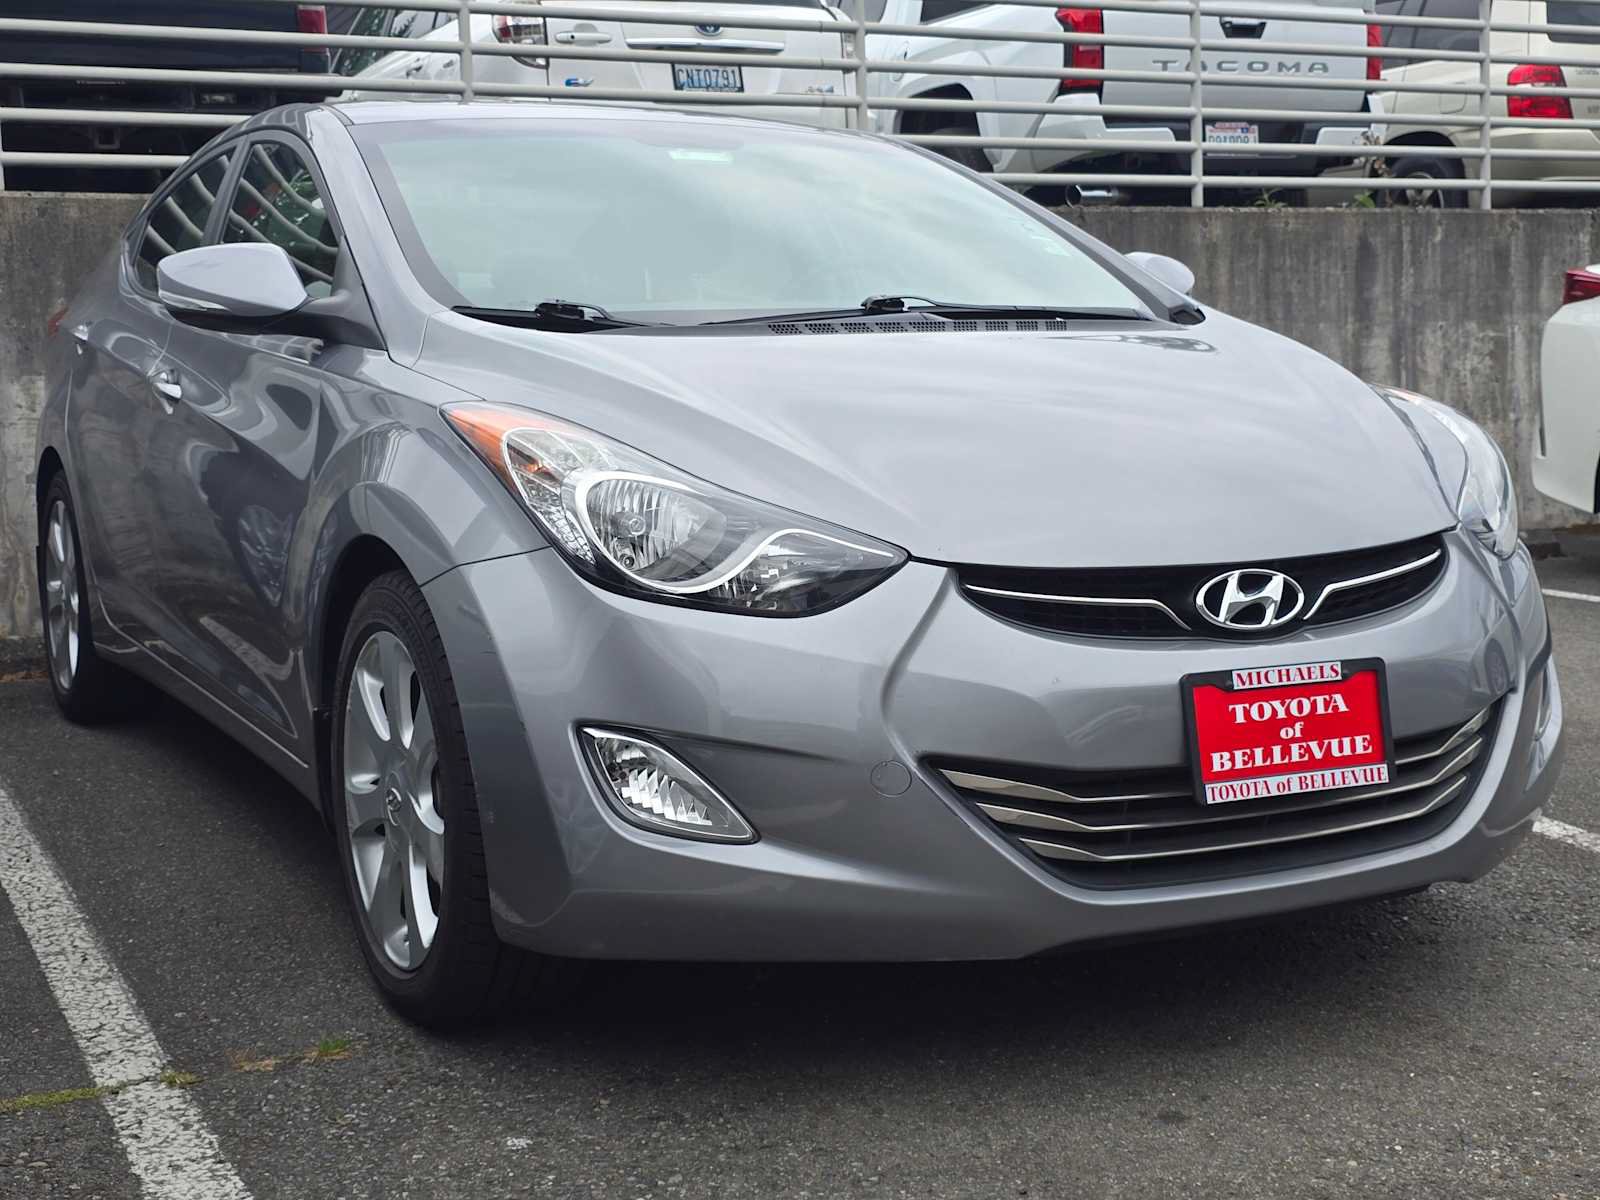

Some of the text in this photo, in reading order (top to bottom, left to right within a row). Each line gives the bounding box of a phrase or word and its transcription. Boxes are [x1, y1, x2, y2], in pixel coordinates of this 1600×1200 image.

[1152, 60, 1329, 73] TACOMA
[1235, 664, 1340, 687] MICHAELS
[1228, 693, 1350, 724] TOYOTA
[1279, 721, 1305, 740] of
[1210, 734, 1373, 773] BELLEVUE
[1207, 766, 1387, 802] TOYOTA of BELLEVUE
